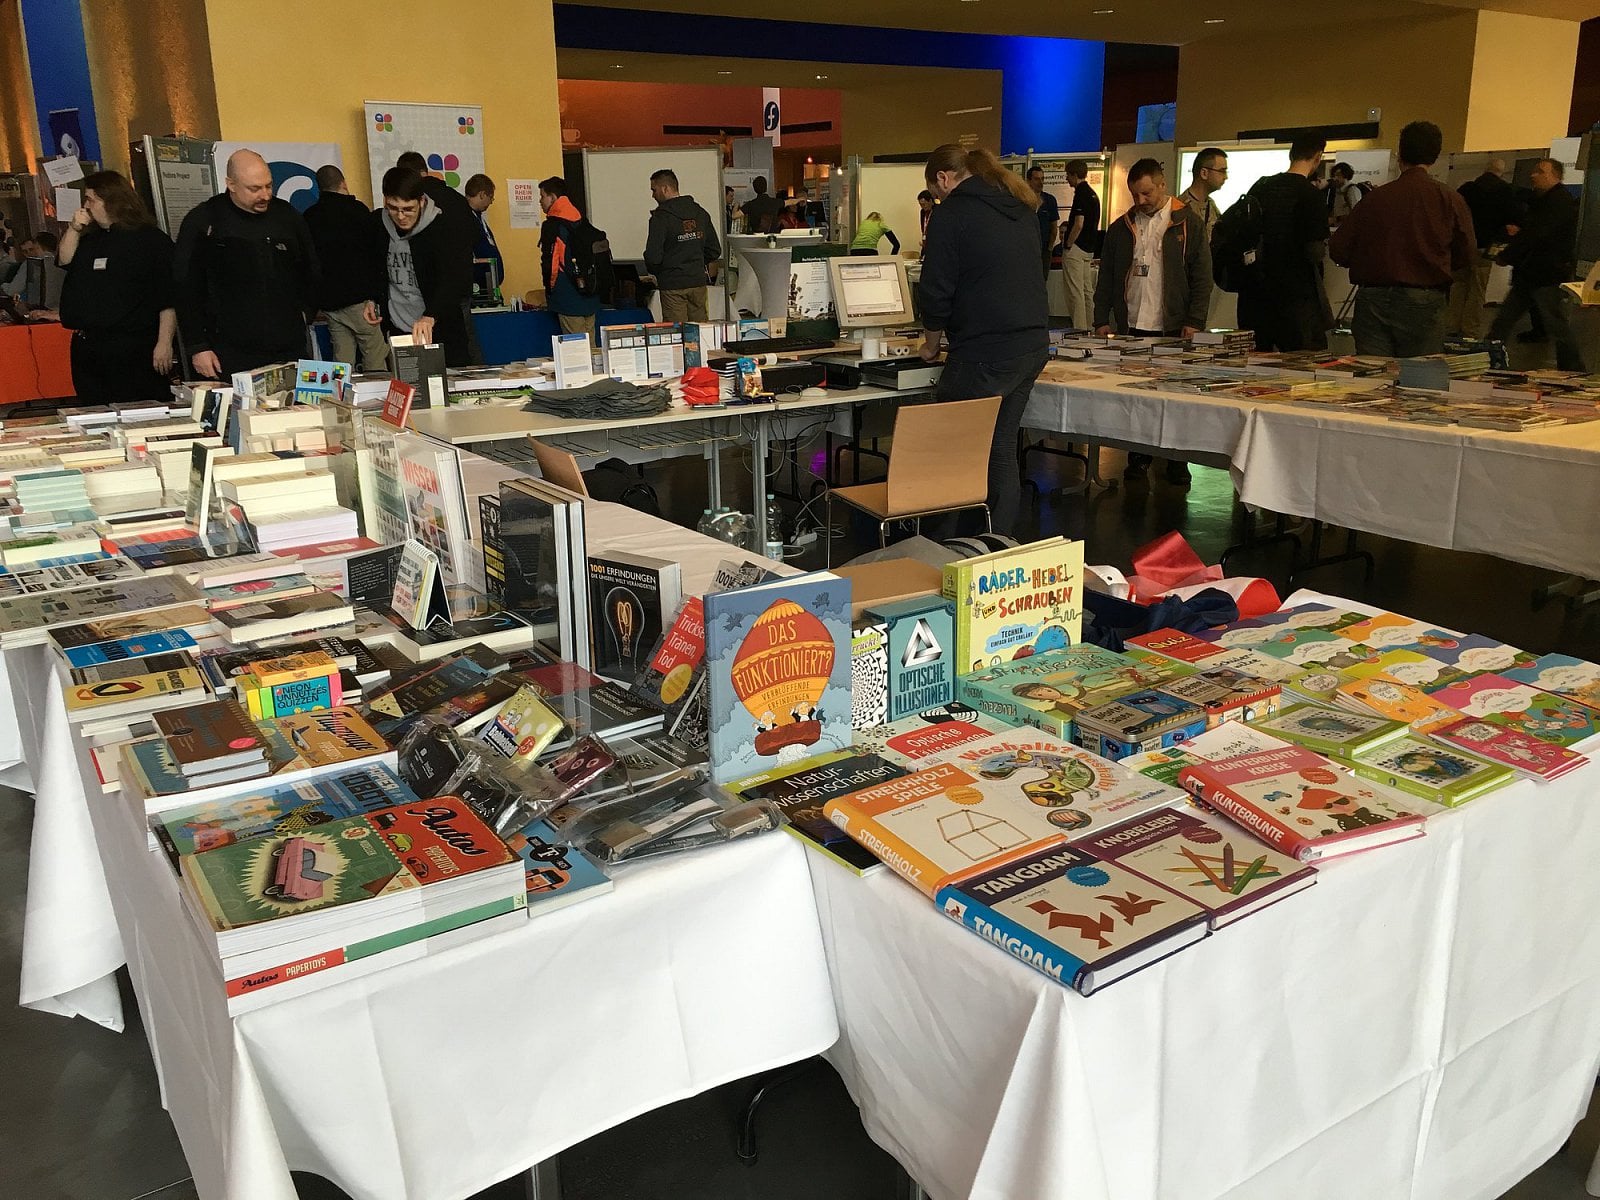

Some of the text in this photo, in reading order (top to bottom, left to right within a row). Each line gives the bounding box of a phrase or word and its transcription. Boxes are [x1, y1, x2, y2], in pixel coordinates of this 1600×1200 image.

[400, 457, 439, 495] WISSEN
[589, 563, 656, 585] 1001 ERFINDUNGEN
[978, 563, 1074, 595] RÄDER, HEBEL
[998, 586, 1073, 618] SCHRAUBEN
[678, 614, 705, 639] Trickse
[768, 620, 797, 646] DAS
[1001, 627, 1024, 639] TECHNIK
[667, 632, 697, 660] Tränen,
[1147, 634, 1194, 650] Quiz
[657, 649, 675, 669] Tod
[734, 649, 833, 698] FUNKTIONIERT?
[899, 662, 946, 693] OPTISCHE
[282, 682, 311, 694] NEON
[761, 681, 811, 701] VERBLÜFFENDE
[894, 681, 950, 716] ILLUSIONEN
[277, 695, 319, 709] QUIZZEN
[767, 693, 811, 711] ERFINDUNGEN
[906, 728, 962, 747] Optische
[1211, 749, 1303, 773] KUNTERBUNTE
[1246, 761, 1293, 776] KREISE
[784, 767, 844, 790] Natur-
[855, 766, 955, 804] STREICHHOLZ
[892, 782, 944, 803] SPIELE
[1211, 790, 1285, 843] KUNTERBUNTE
[405, 807, 488, 857] Autos
[1094, 813, 1182, 849] KNOBELEIEN
[857, 828, 925, 882] STREICHHOLZ
[972, 851, 1081, 897] TANGRAM
[285, 957, 327, 977] PAPERTOYS
[241, 972, 280, 989] Autos
